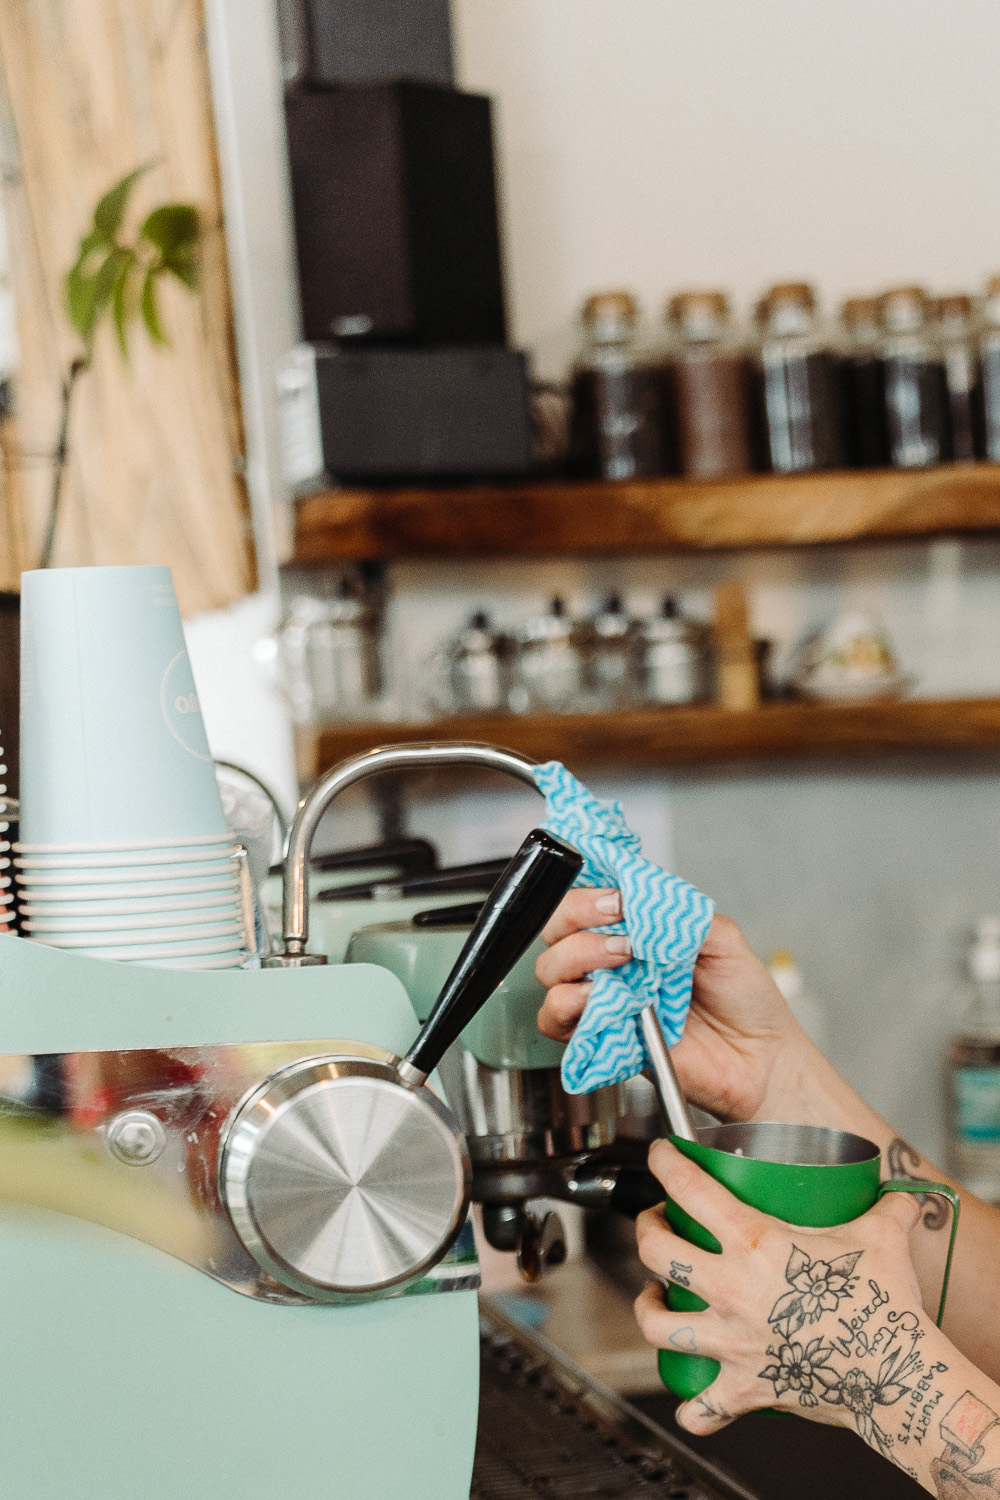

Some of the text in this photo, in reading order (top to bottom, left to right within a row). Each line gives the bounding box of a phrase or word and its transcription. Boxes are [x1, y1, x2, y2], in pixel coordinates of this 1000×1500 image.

[829, 1279, 889, 1358] Weird
[855, 1311, 919, 1358] Stay
[914, 1390, 944, 1446] MURTY
